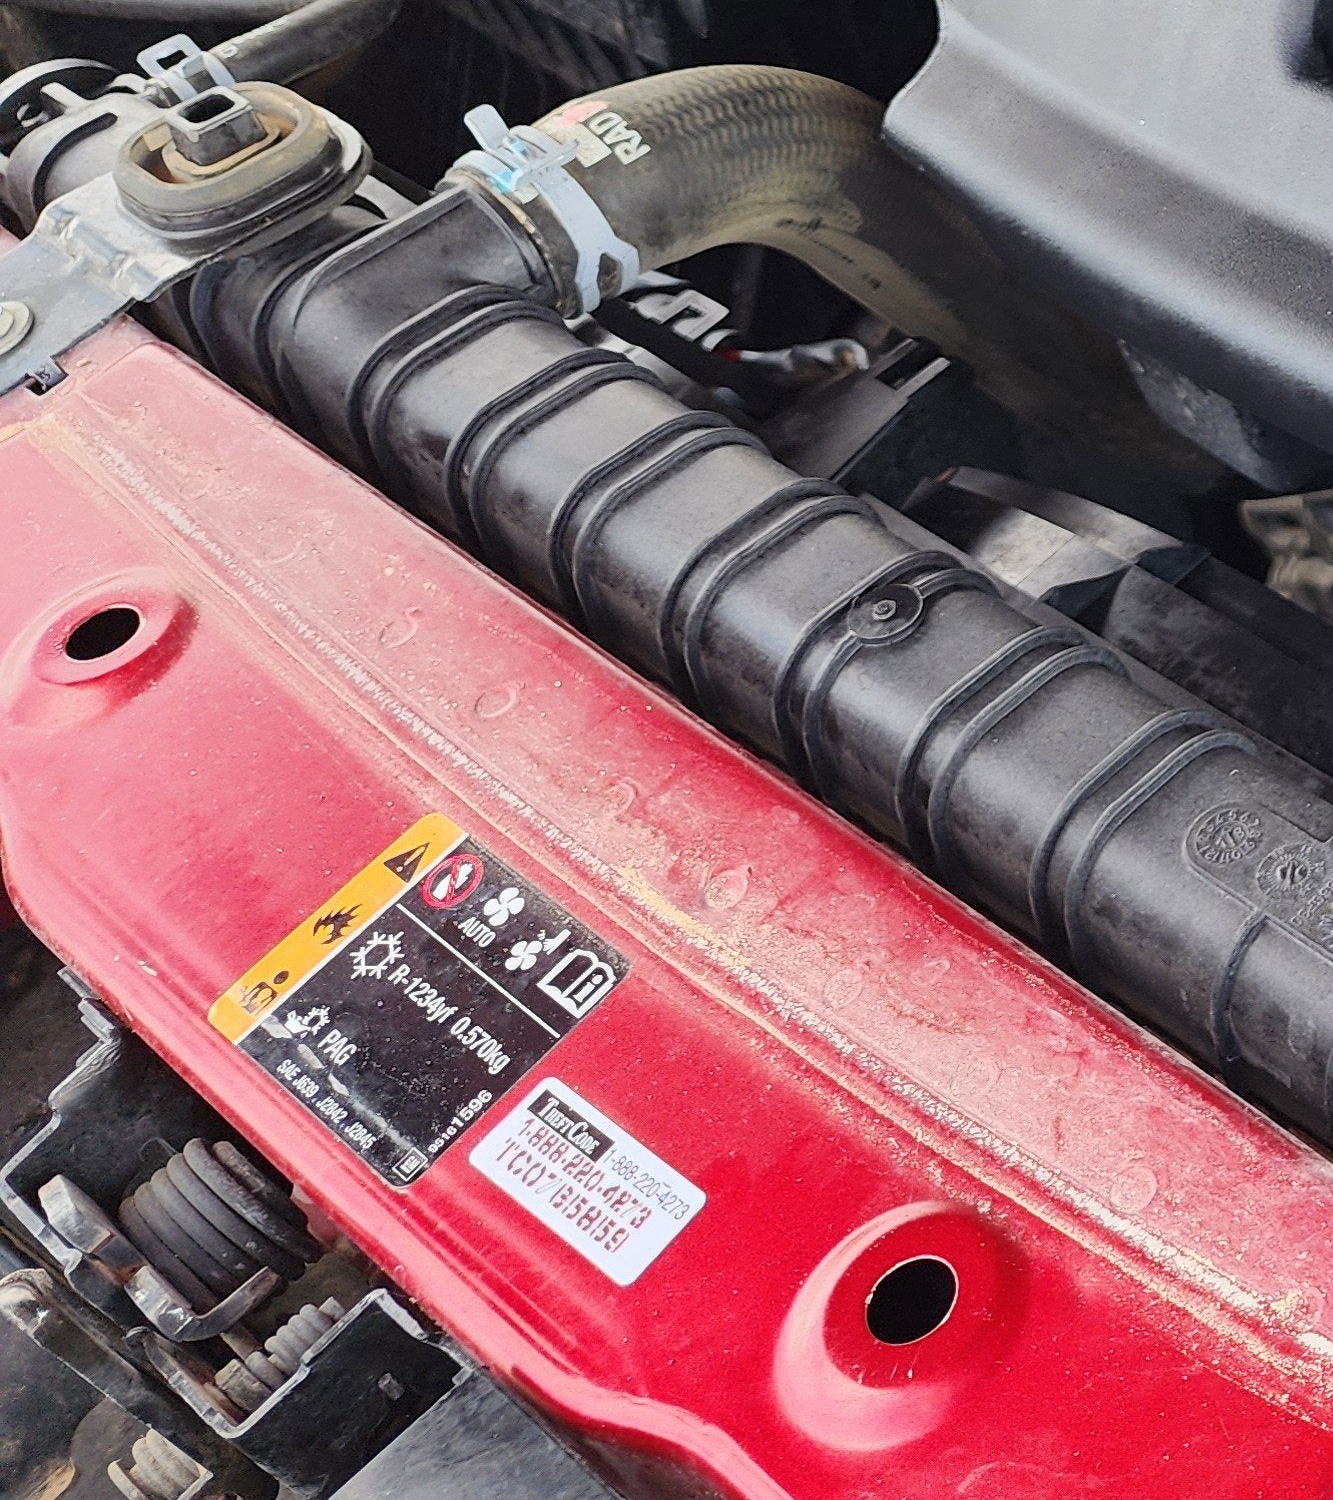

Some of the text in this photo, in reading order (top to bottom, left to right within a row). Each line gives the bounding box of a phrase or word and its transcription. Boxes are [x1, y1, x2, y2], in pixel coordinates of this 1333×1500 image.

[588, 111, 652, 166] RAD
[458, 916, 497, 948] AUTO
[317, 1028, 357, 1066] PAG
[387, 963, 511, 1075] R-1234yf 0.570kg
[276, 1058, 301, 1081] SAE
[344, 1120, 378, 1150] J2845
[427, 1089, 493, 1153] 95161596
[602, 1148, 691, 1221] 1-888-220-4273
